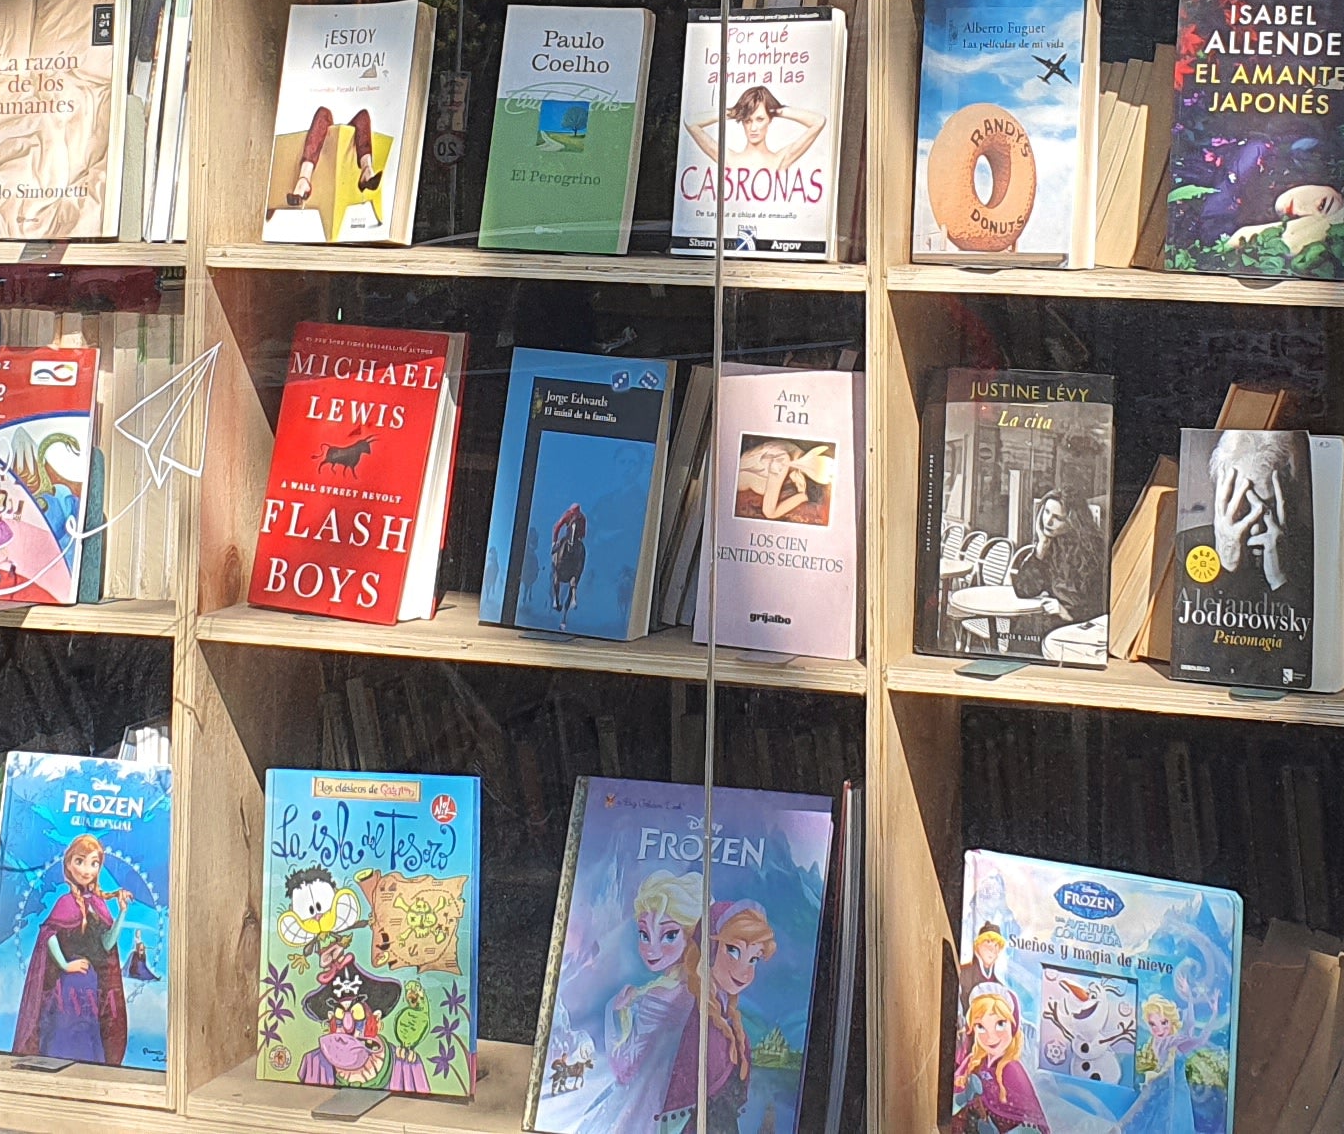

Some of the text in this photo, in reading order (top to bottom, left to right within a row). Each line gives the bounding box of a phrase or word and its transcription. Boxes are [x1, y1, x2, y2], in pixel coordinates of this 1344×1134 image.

[1231, 4, 1317, 26] ISABEL
[324, 28, 376, 48] ¡ESTOY
[543, 30, 605, 50] Paulo
[963, 21, 1046, 37] Alberto Fuguet
[1204, 29, 1342, 56] ALLENDE
[25, 50, 80, 71] razón
[311, 52, 386, 70] AGOTADA!
[531, 54, 610, 74] Coelho
[7, 73, 64, 93] de los
[1195, 63, 1221, 84] EL
[1208, 88, 1329, 114] JAPONÉS
[15, 182, 89, 199] Simonetti
[680, 166, 823, 204] CABRONAS
[970, 208, 1025, 235] DONUTS
[290, 351, 439, 391] MICHAEL
[545, 389, 609, 407] Jorge Edwards
[776, 389, 810, 408] Amy
[970, 381, 1089, 403] JUSTINE LÉVY
[306, 395, 406, 430] LEWIS
[774, 404, 810, 425] Tan
[997, 410, 1053, 430] La cita
[260, 498, 413, 553] FLASH
[749, 532, 808, 552] LOS CIEN
[777, 553, 844, 574] SECRETOS
[263, 557, 380, 609] BOYS
[1178, 600, 1312, 641] Jodorowsky
[1212, 629, 1283, 652] Psicomagia
[62, 789, 145, 818] FROZEN
[636, 826, 766, 869] FROZEN
[1063, 890, 1116, 913] FROZEN
[1009, 933, 1174, 975] Sueños y magia de nieve
